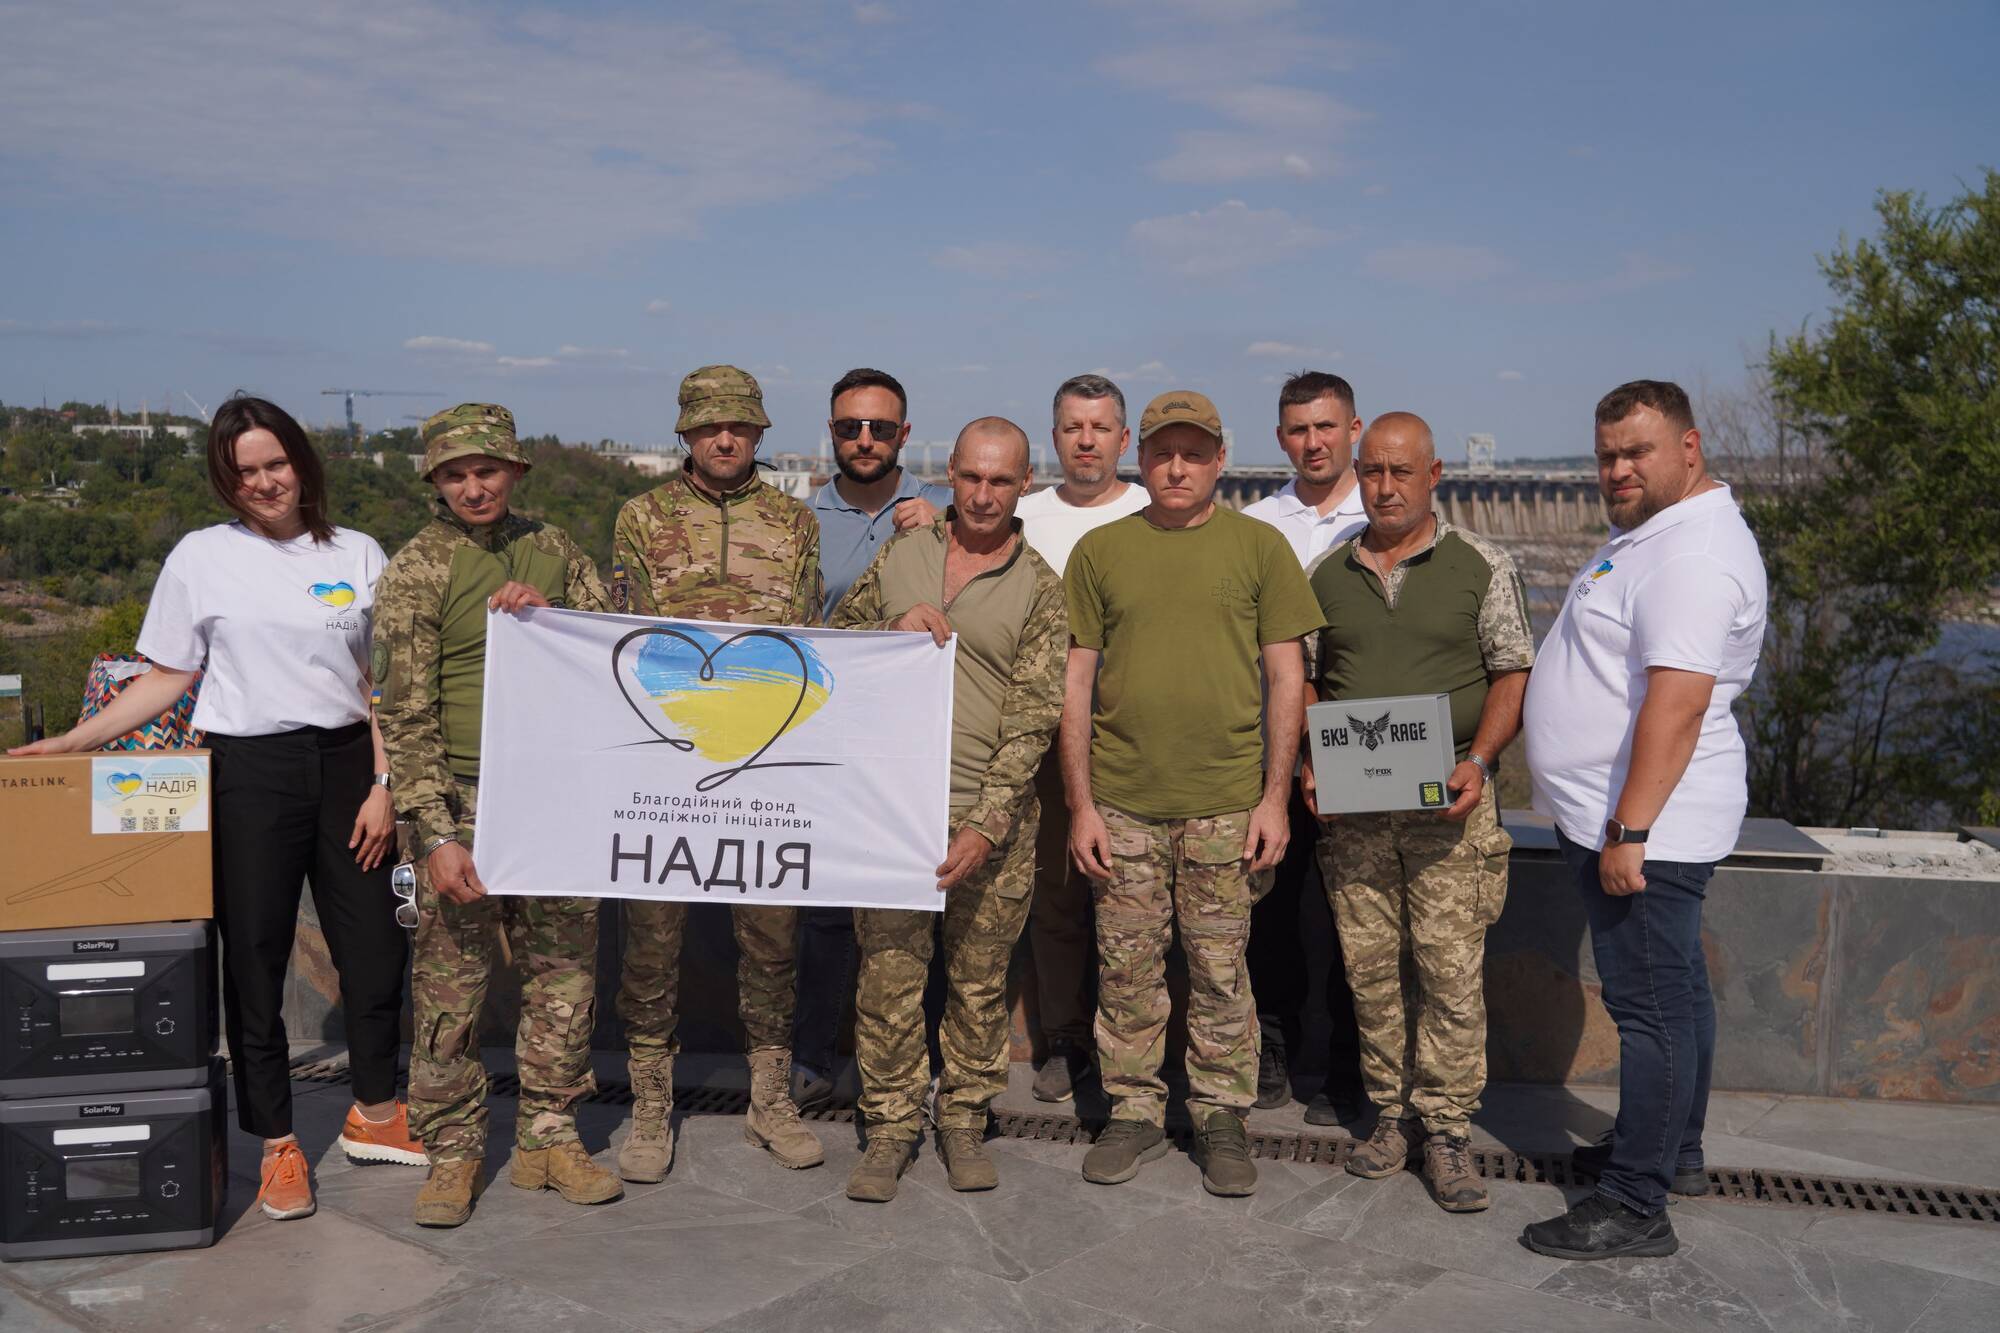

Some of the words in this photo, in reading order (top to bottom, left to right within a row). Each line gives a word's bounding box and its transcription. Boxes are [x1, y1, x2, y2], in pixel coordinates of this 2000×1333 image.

[326, 621, 359, 631] НАДІЯ
[1321, 727, 1349, 747] SKY
[1390, 722, 1427, 742] RAGE
[0, 777, 66, 788] TARLINK
[146, 780, 197, 793] НАДІЯ
[632, 792, 742, 810] Благодійний
[750, 799, 796, 814] фонд
[614, 809, 718, 824] молодіжної
[725, 812, 812, 829] ініціативи
[610, 833, 811, 893] НАДІЯ
[77, 941, 115, 950] SolarPlay
[83, 1105, 120, 1115] SolarPlay
